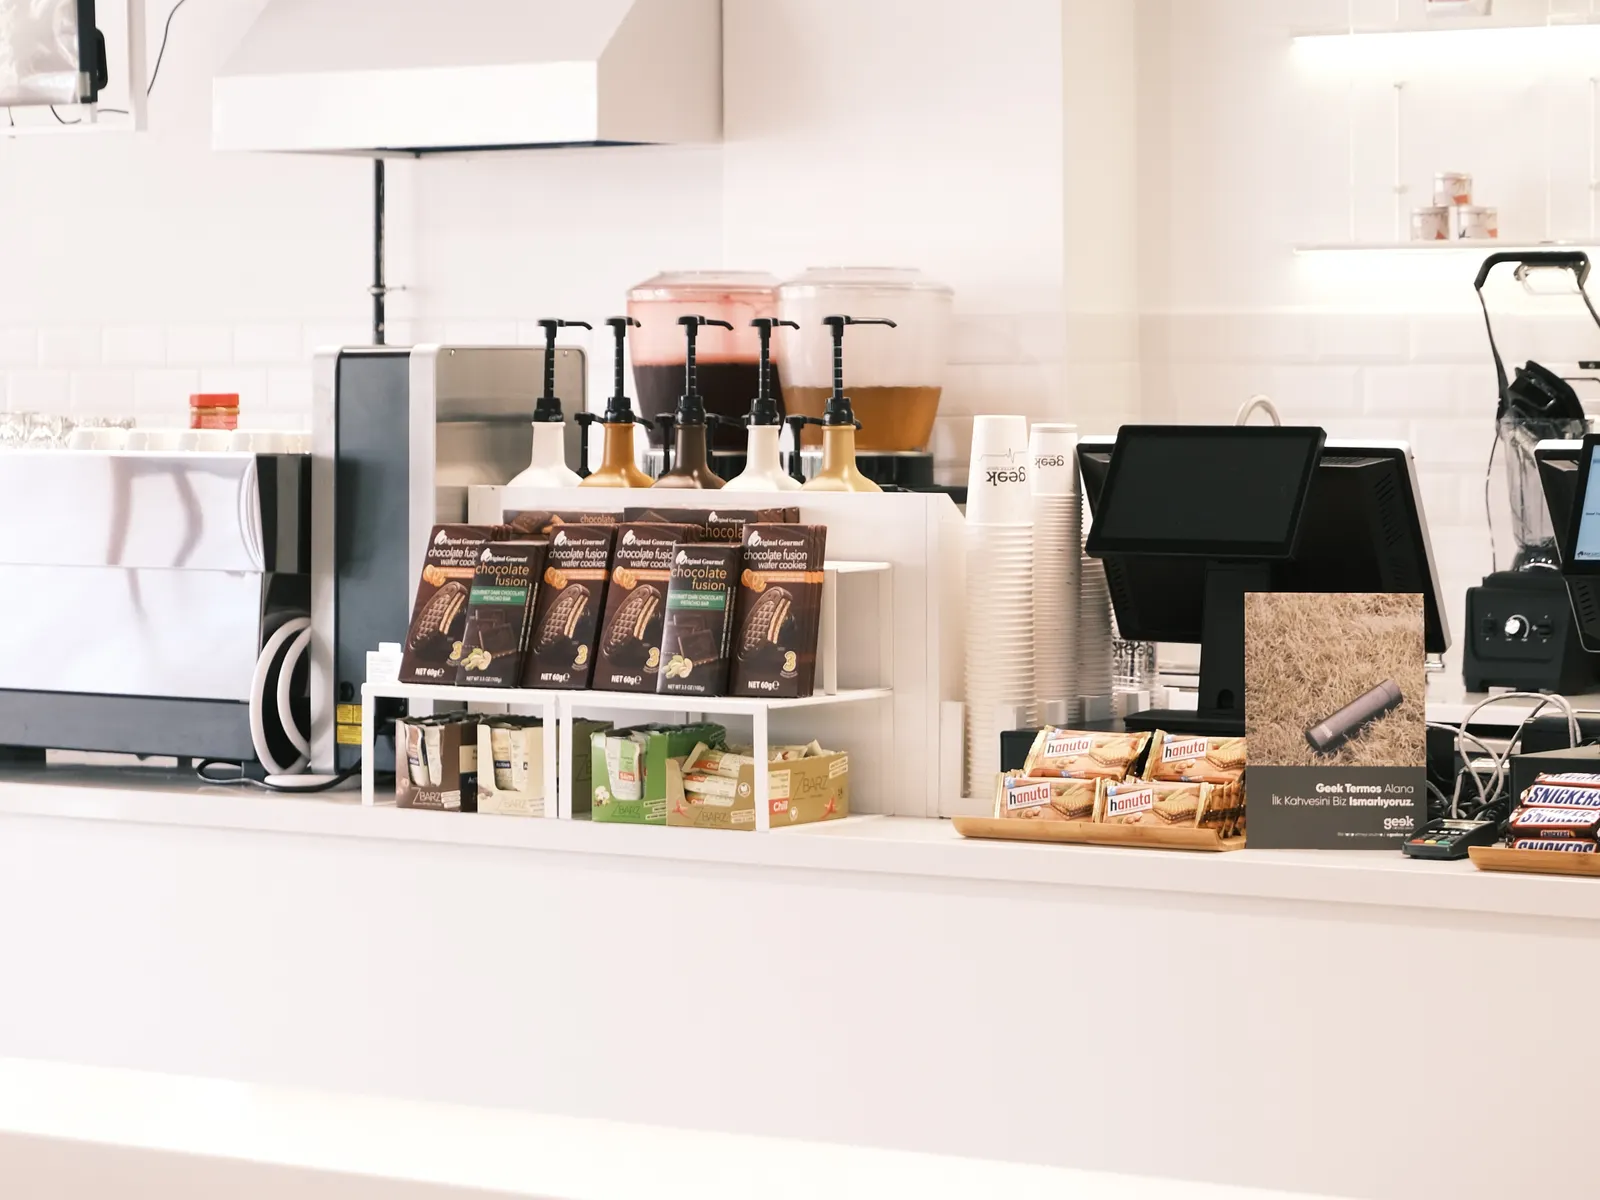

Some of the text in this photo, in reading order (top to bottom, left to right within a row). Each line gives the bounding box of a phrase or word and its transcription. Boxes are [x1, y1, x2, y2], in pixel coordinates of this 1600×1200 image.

[986, 466, 1026, 486] geek
[580, 514, 616, 523] chocolate
[700, 522, 743, 539] chocola
[428, 546, 478, 558] chocolate fusi
[549, 547, 608, 559] chocolate fusion
[617, 547, 673, 559] chocolate fusio
[744, 548, 808, 560] chocolate fusion
[440, 557, 476, 567] wafer cook
[561, 558, 606, 568] wafer cookies
[630, 558, 671, 569] wafer cooki
[758, 560, 807, 570] wafer cookies
[475, 563, 530, 576] chocolate
[671, 566, 727, 579] chocolate
[495, 575, 528, 587] fusion
[692, 578, 726, 591] fusion
[415, 667, 426, 676] NET
[540, 672, 551, 681] NET
[611, 675, 623, 683] NET
[748, 681, 760, 689] NET
[1047, 739, 1089, 754] hanuta
[1164, 741, 1205, 758] hanuta
[1316, 783, 1414, 793] Geek Termos Alana
[1009, 787, 1049, 805] hanuta
[1110, 792, 1151, 811] hanuta
[1272, 794, 1282, 806] İlk
[1284, 795, 1331, 806] Kahvesini
[1333, 795, 1347, 806] Biz
[1384, 815, 1414, 830] geek
